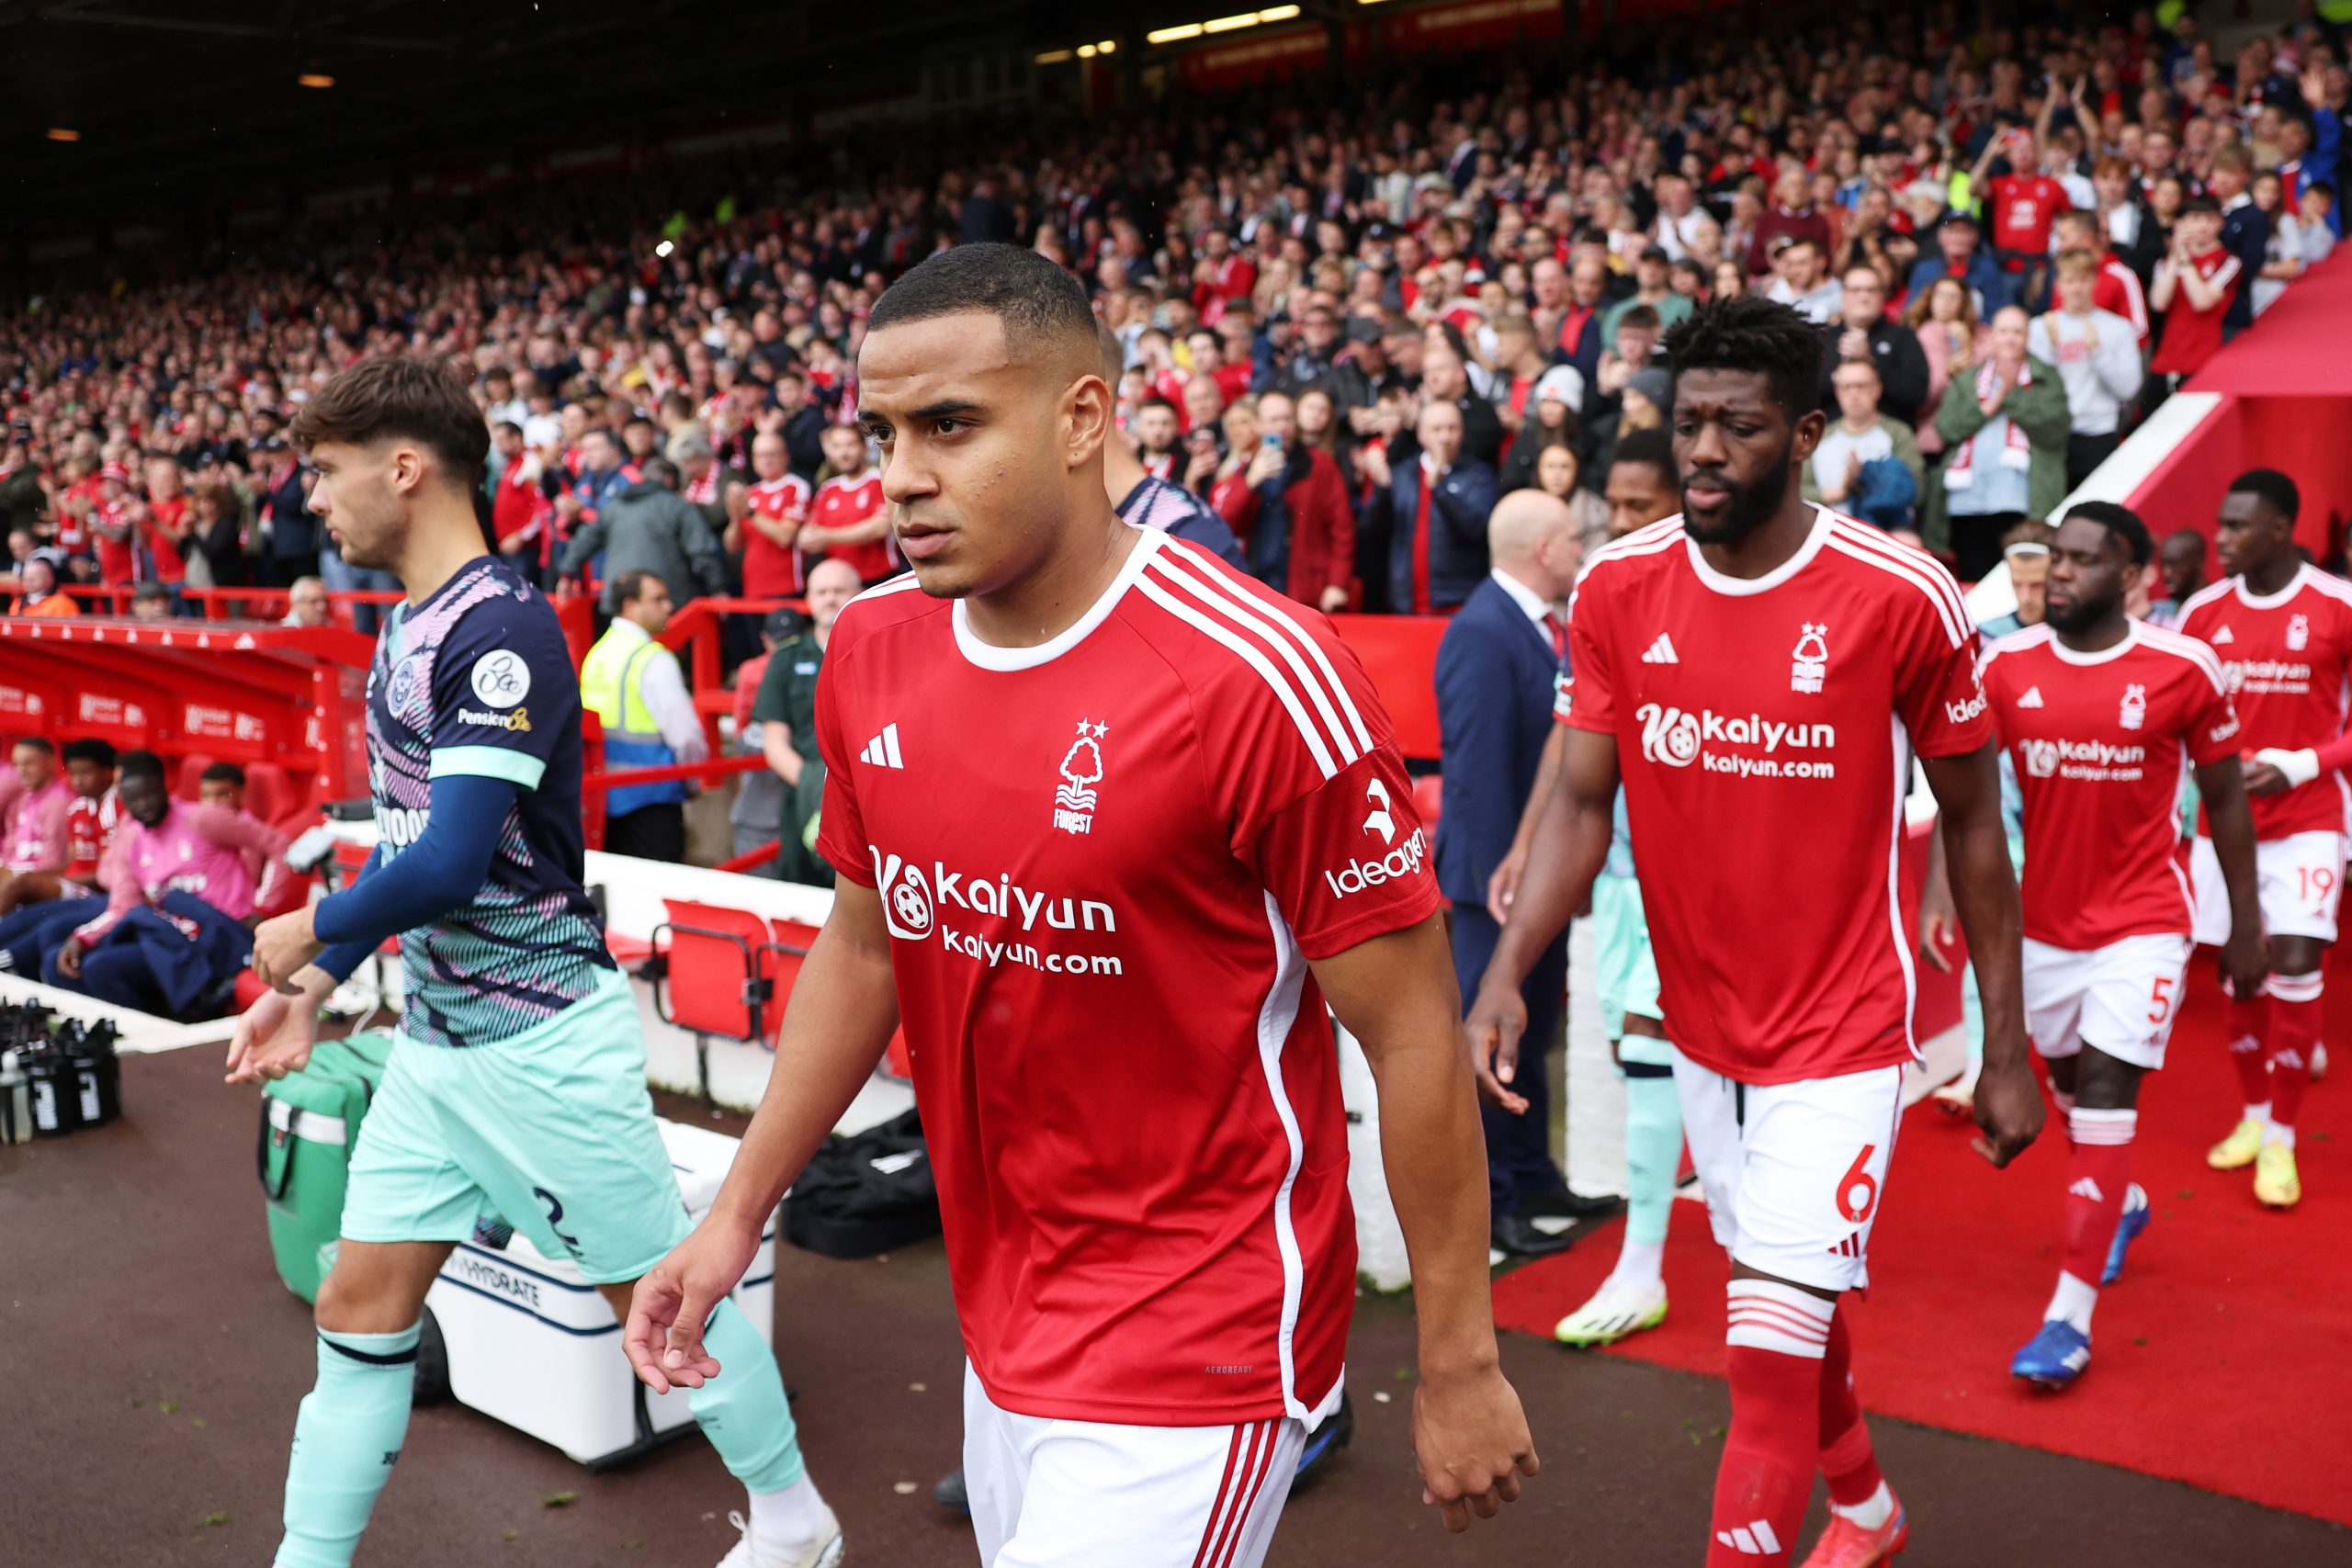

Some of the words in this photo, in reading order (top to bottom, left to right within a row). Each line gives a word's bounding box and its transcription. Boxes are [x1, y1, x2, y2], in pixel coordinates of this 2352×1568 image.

[1325, 827, 1427, 899] Ideagen
[2297, 867, 2335, 901] 19
[2147, 976, 2173, 1024] 5
[1836, 1144, 1876, 1224] 6
[532, 1186, 579, 1247] 2
[1204, 1365, 1253, 1374] AEROREADY
